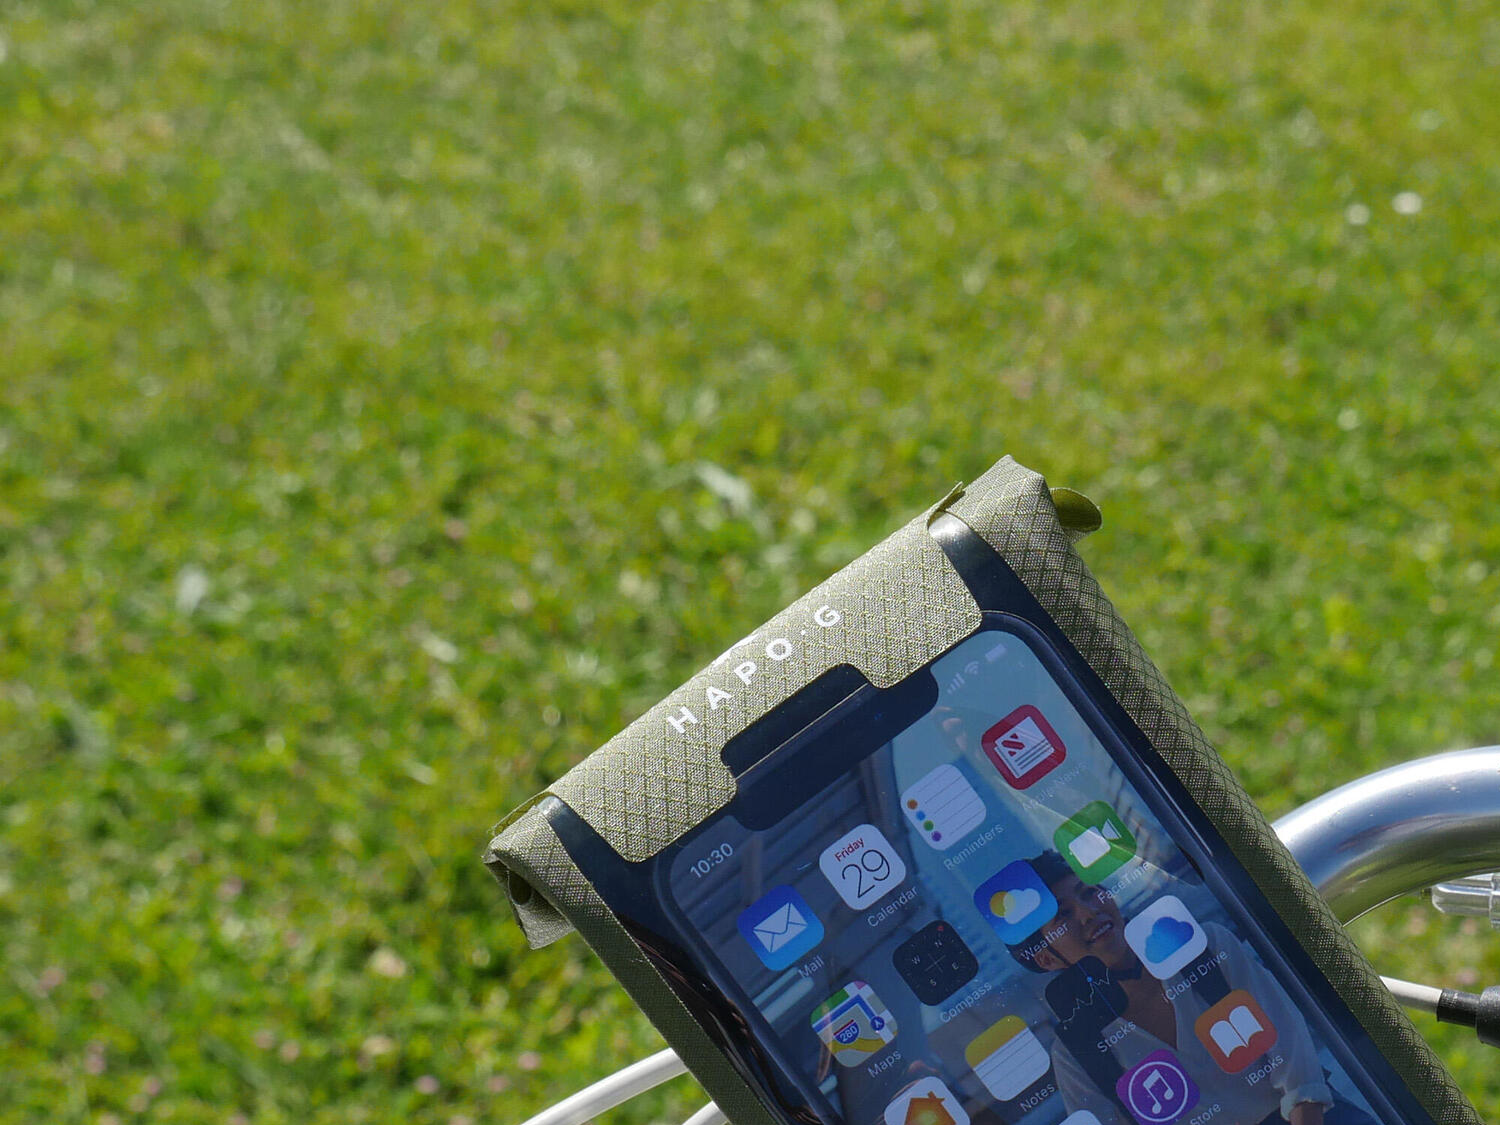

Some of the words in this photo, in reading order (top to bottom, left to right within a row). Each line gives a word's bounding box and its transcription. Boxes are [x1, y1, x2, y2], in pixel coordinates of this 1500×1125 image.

[690, 842, 734, 879] 10:30
[834, 837, 865, 863] Friday
[943, 823, 1005, 871] Reminders
[841, 849, 891, 899] 29
[1097, 861, 1151, 904] FaceTime
[867, 886, 920, 928] Calendar
[1021, 922, 1070, 962] Weather
[798, 956, 825, 979] Mail
[1162, 971, 1198, 1004] iCloud
[1198, 950, 1229, 977] Drive
[939, 981, 993, 1023] Compass
[840, 1026, 858, 1043] 280
[1097, 1019, 1137, 1053] Stocks
[867, 1050, 902, 1078] Maps
[1245, 1054, 1284, 1087] iBooks
[1020, 1083, 1055, 1112] Notes
